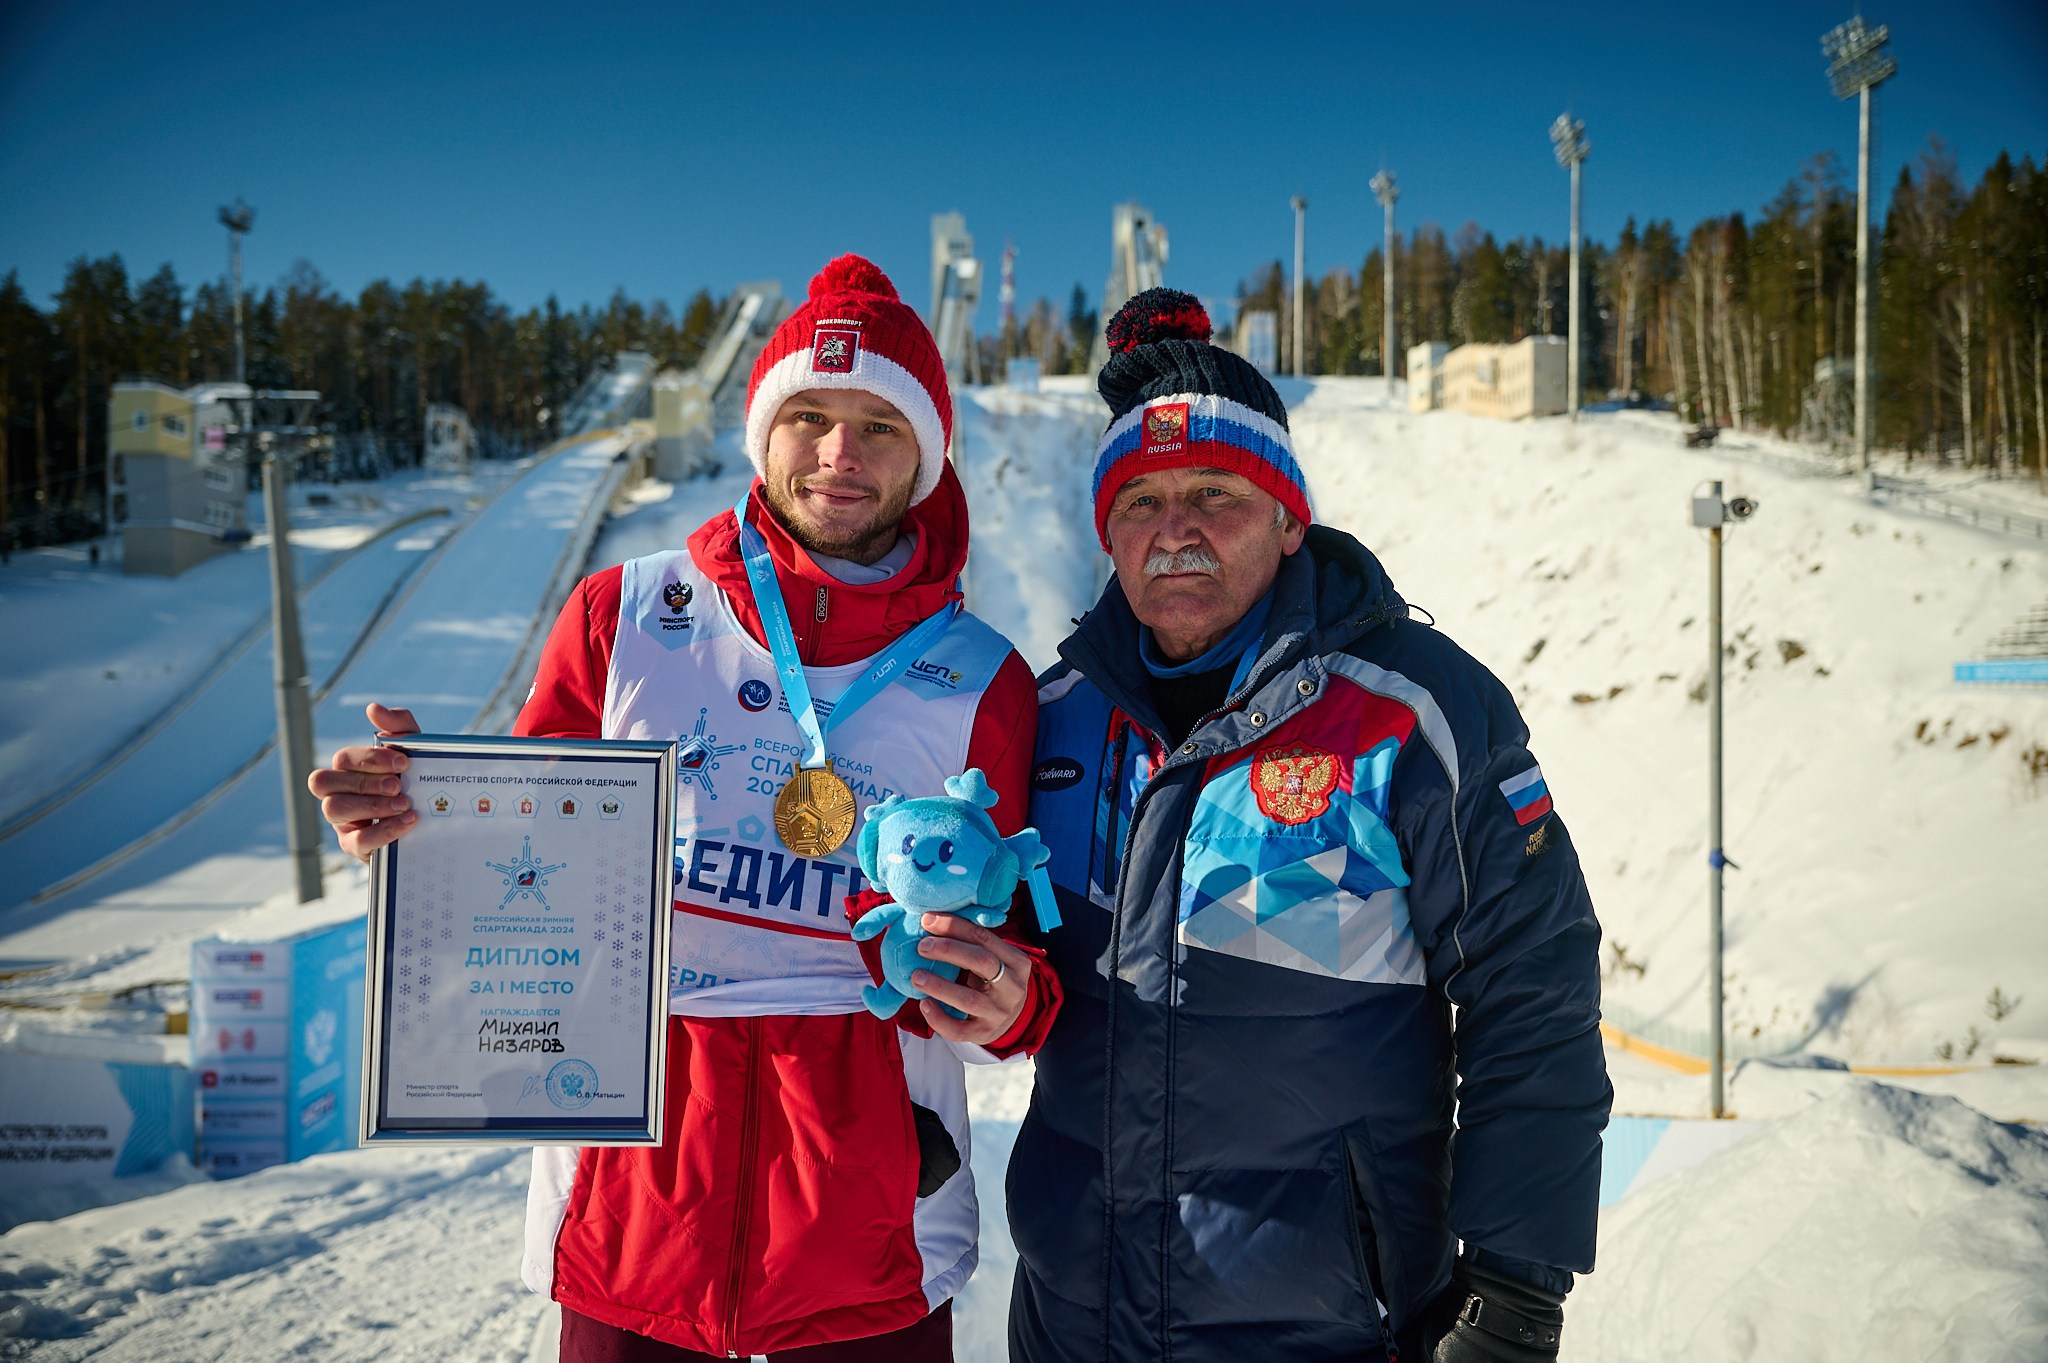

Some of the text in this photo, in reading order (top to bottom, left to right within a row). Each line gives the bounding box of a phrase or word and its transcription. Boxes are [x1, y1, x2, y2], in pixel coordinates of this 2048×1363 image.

[1147, 442, 1182, 454] RUSSIA
[818, 592, 826, 617] BOSCO
[659, 616, 695, 624] МИНСПОРТ
[662, 623, 690, 631] РОССИИ
[1035, 767, 1076, 781] FORWARD
[419, 775, 637, 787] МИНИСТЕРСТВО СПОРТА РОССИЙСКОЙ ФЕДЕРАЦИИ
[473, 915, 541, 923] ВСЕРОССИЙСКАЯ
[473, 925, 575, 934] СПАРТАКИАДА 2024
[465, 947, 580, 968] ДИПЛОМ
[469, 980, 495, 994] ЗА
[510, 980, 574, 995] МЕСТО
[480, 1008, 561, 1017] НАГРАЖДАЕТСЯ
[445, 1091, 483, 1099] Федерации
[593, 1091, 625, 1099] Матыцин
